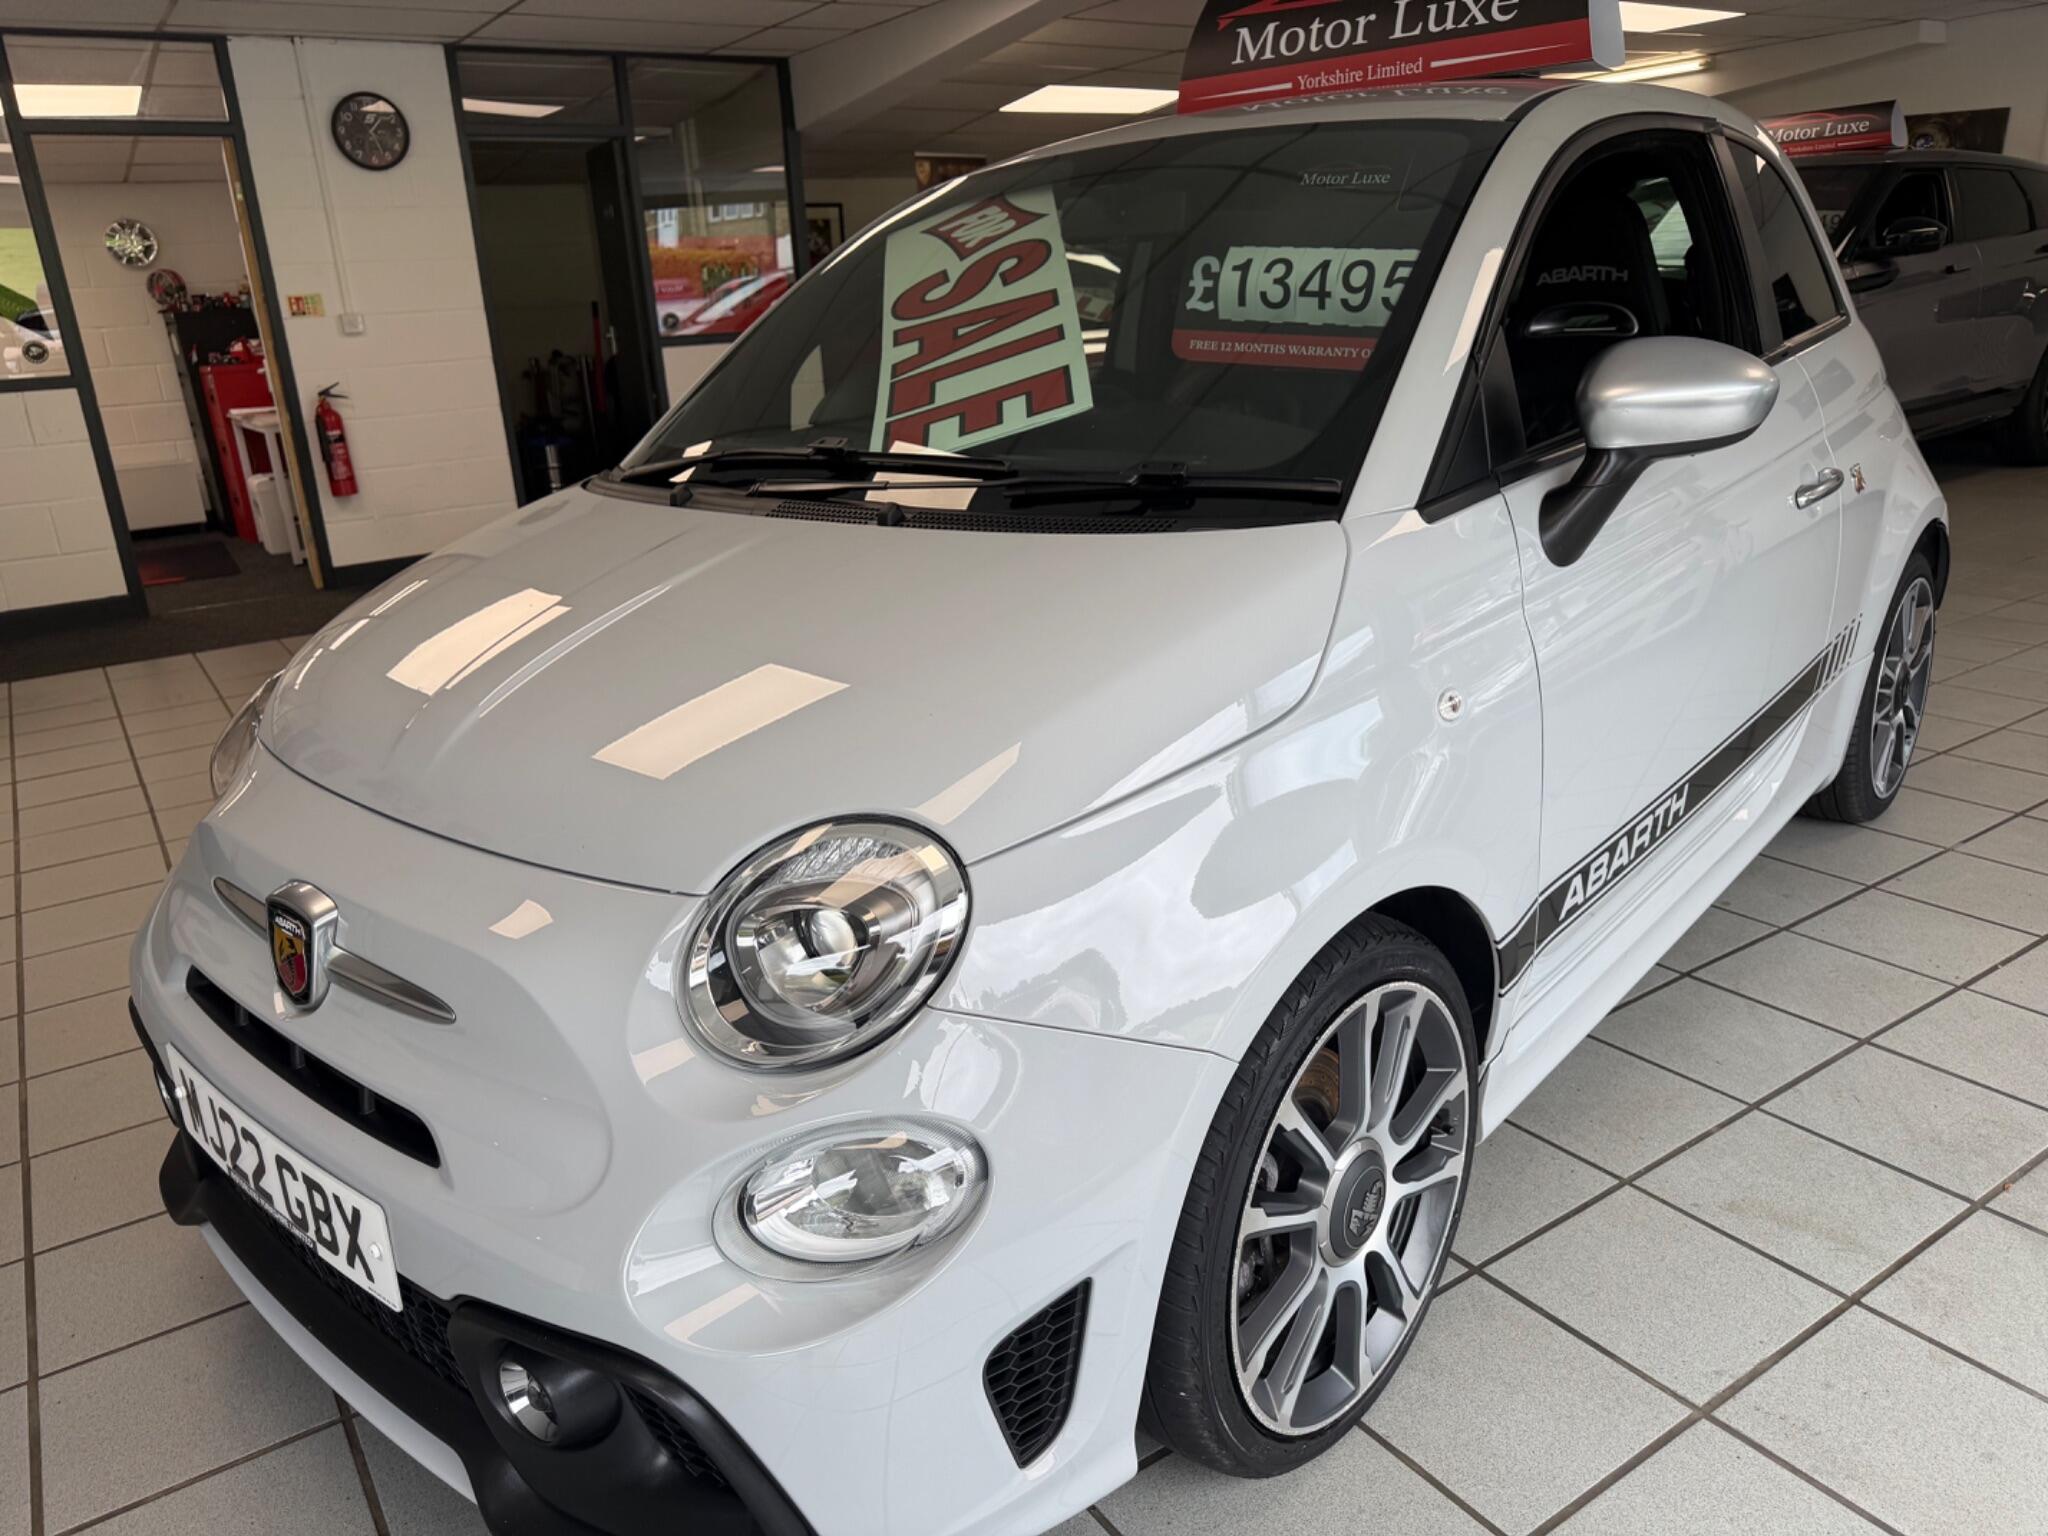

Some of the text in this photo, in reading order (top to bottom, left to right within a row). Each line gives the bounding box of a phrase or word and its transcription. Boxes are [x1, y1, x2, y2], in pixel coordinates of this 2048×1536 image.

[1231, 0, 1519, 66] Motor Luxe
[1297, 58, 1423, 92] Yorkshire Limited
[1824, 120, 1870, 137] Luxe
[1300, 171, 1391, 186] Motor Luxe
[1186, 255, 1416, 313] £13495
[1536, 265, 1629, 286] ABARTH
[882, 238, 1074, 453] SALE
[1189, 339, 1219, 351] FREE
[1220, 341, 1233, 352] 12
[1234, 342, 1286, 355] MONTHS
[1288, 344, 1360, 358] WARRANTY
[1559, 782, 1689, 922] ABARTH
[275, 915, 305, 938] ABARTH
[179, 1067, 274, 1210] MJ22
[275, 1153, 375, 1285] GBX
